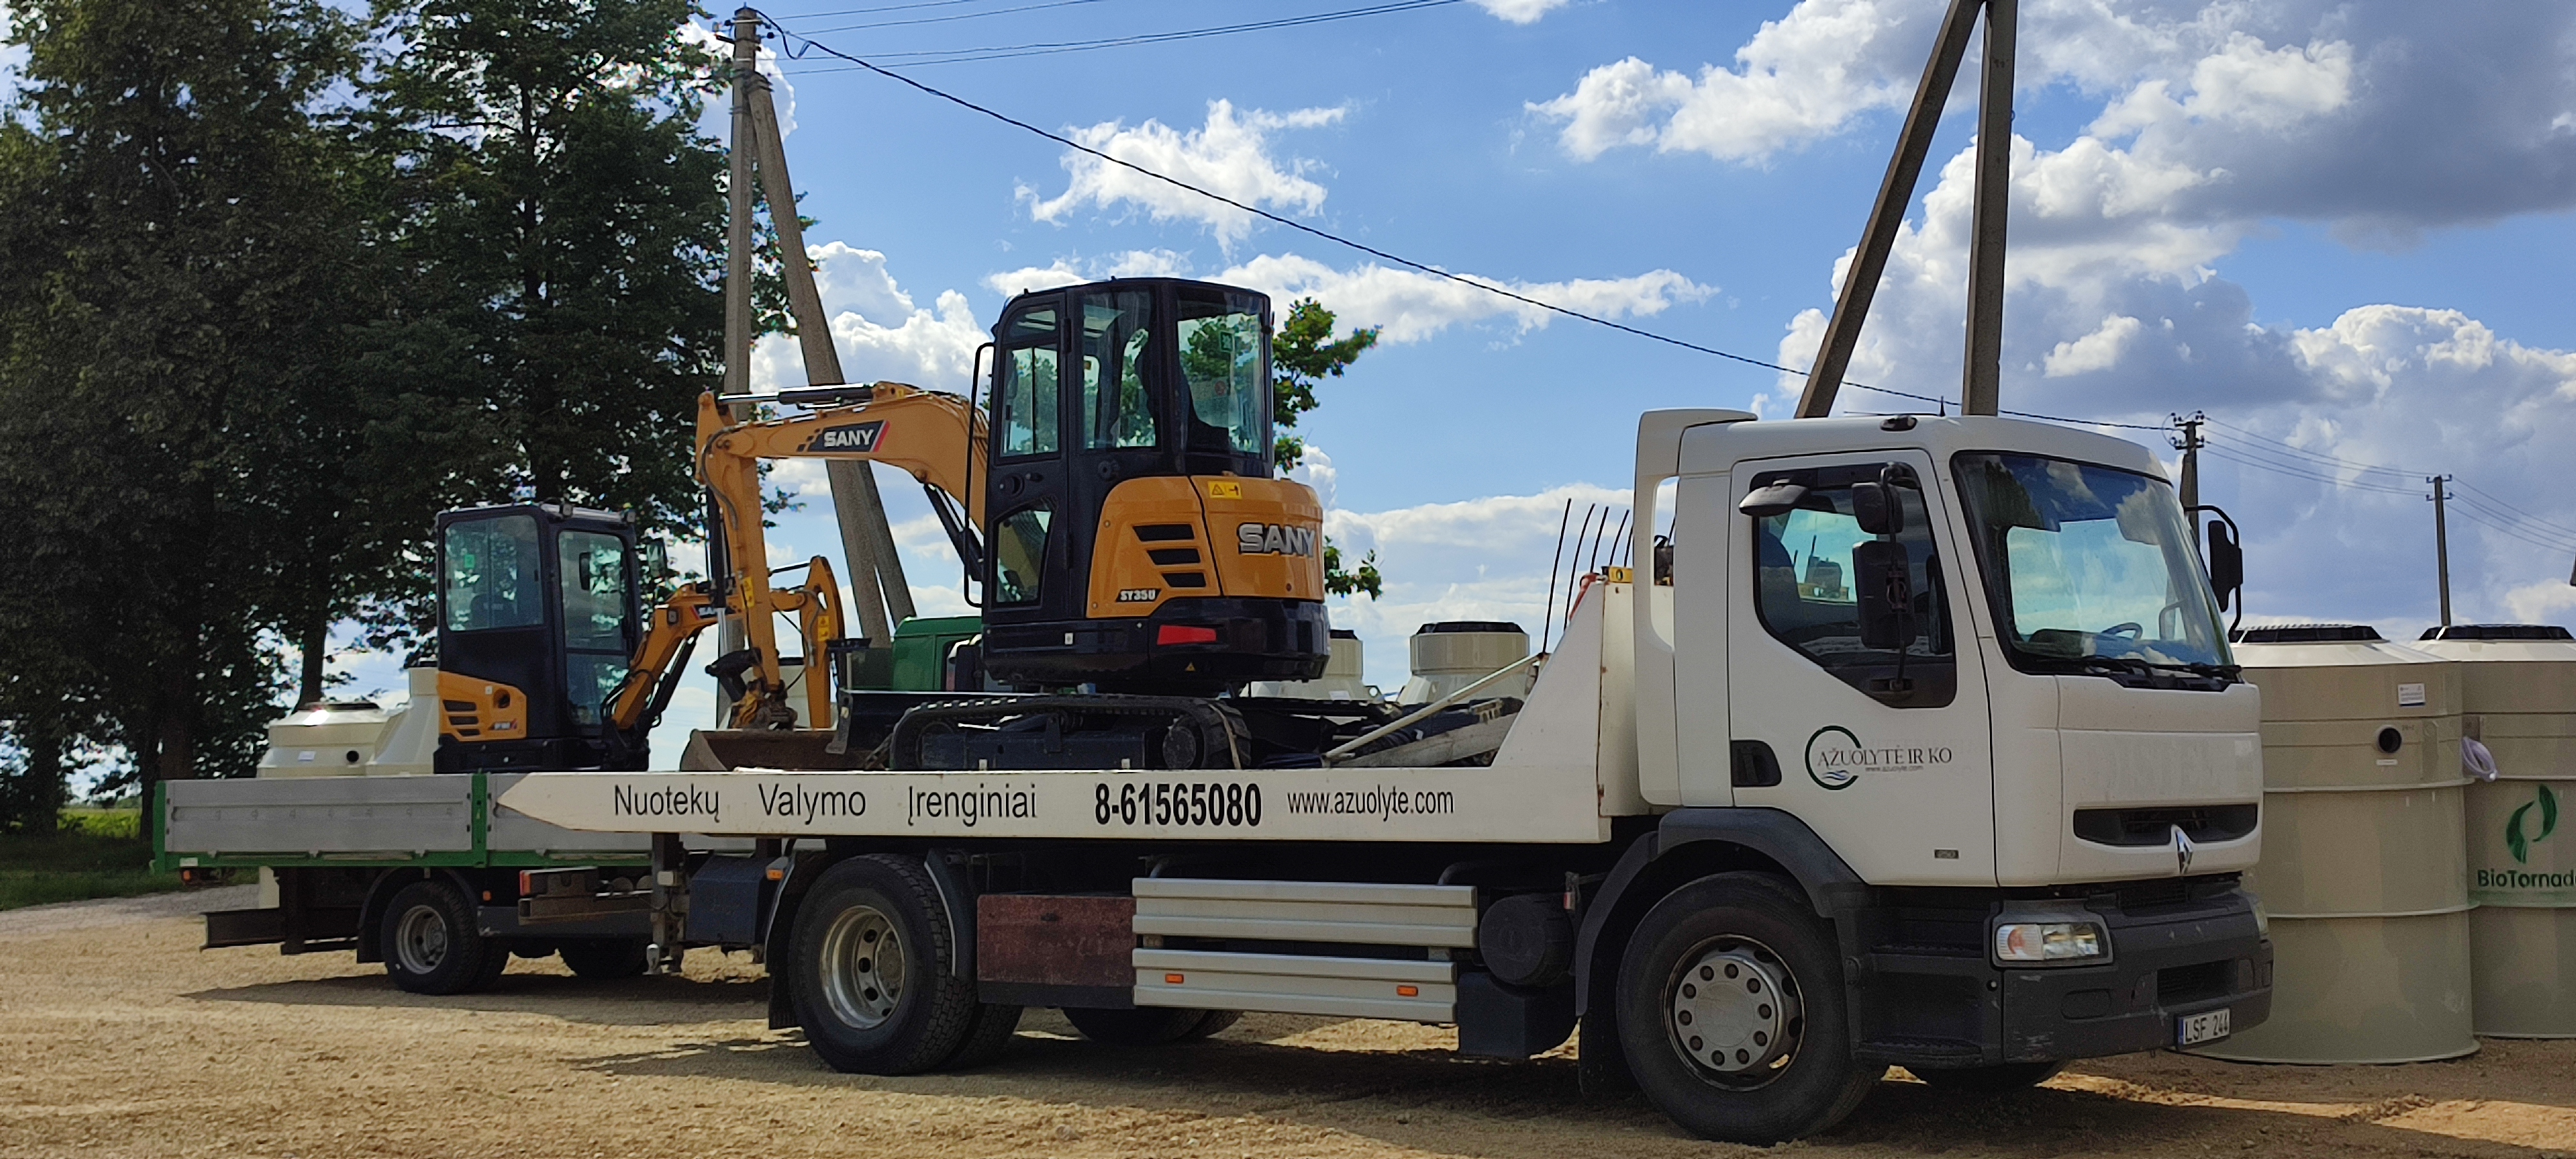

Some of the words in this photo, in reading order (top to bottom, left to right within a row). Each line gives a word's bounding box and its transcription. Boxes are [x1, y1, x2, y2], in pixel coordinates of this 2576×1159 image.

[824, 429, 874, 447] SANY
[1238, 523, 1316, 558] SANY
[1120, 589, 1156, 601] SY35U
[1908, 748, 1924, 764] IR
[1928, 747, 1952, 764] KO
[614, 784, 720, 823] Nuotekų
[758, 783, 866, 825] Valymo
[907, 783, 1036, 827] Įrenginiai
[1095, 783, 1262, 827] 8-61565080
[1287, 784, 1454, 822] www.azuolyte.com
[2477, 867, 2576, 889] BioTornad
[2185, 1017, 2207, 1042] LSF
[2213, 1012, 2228, 1037] 244
